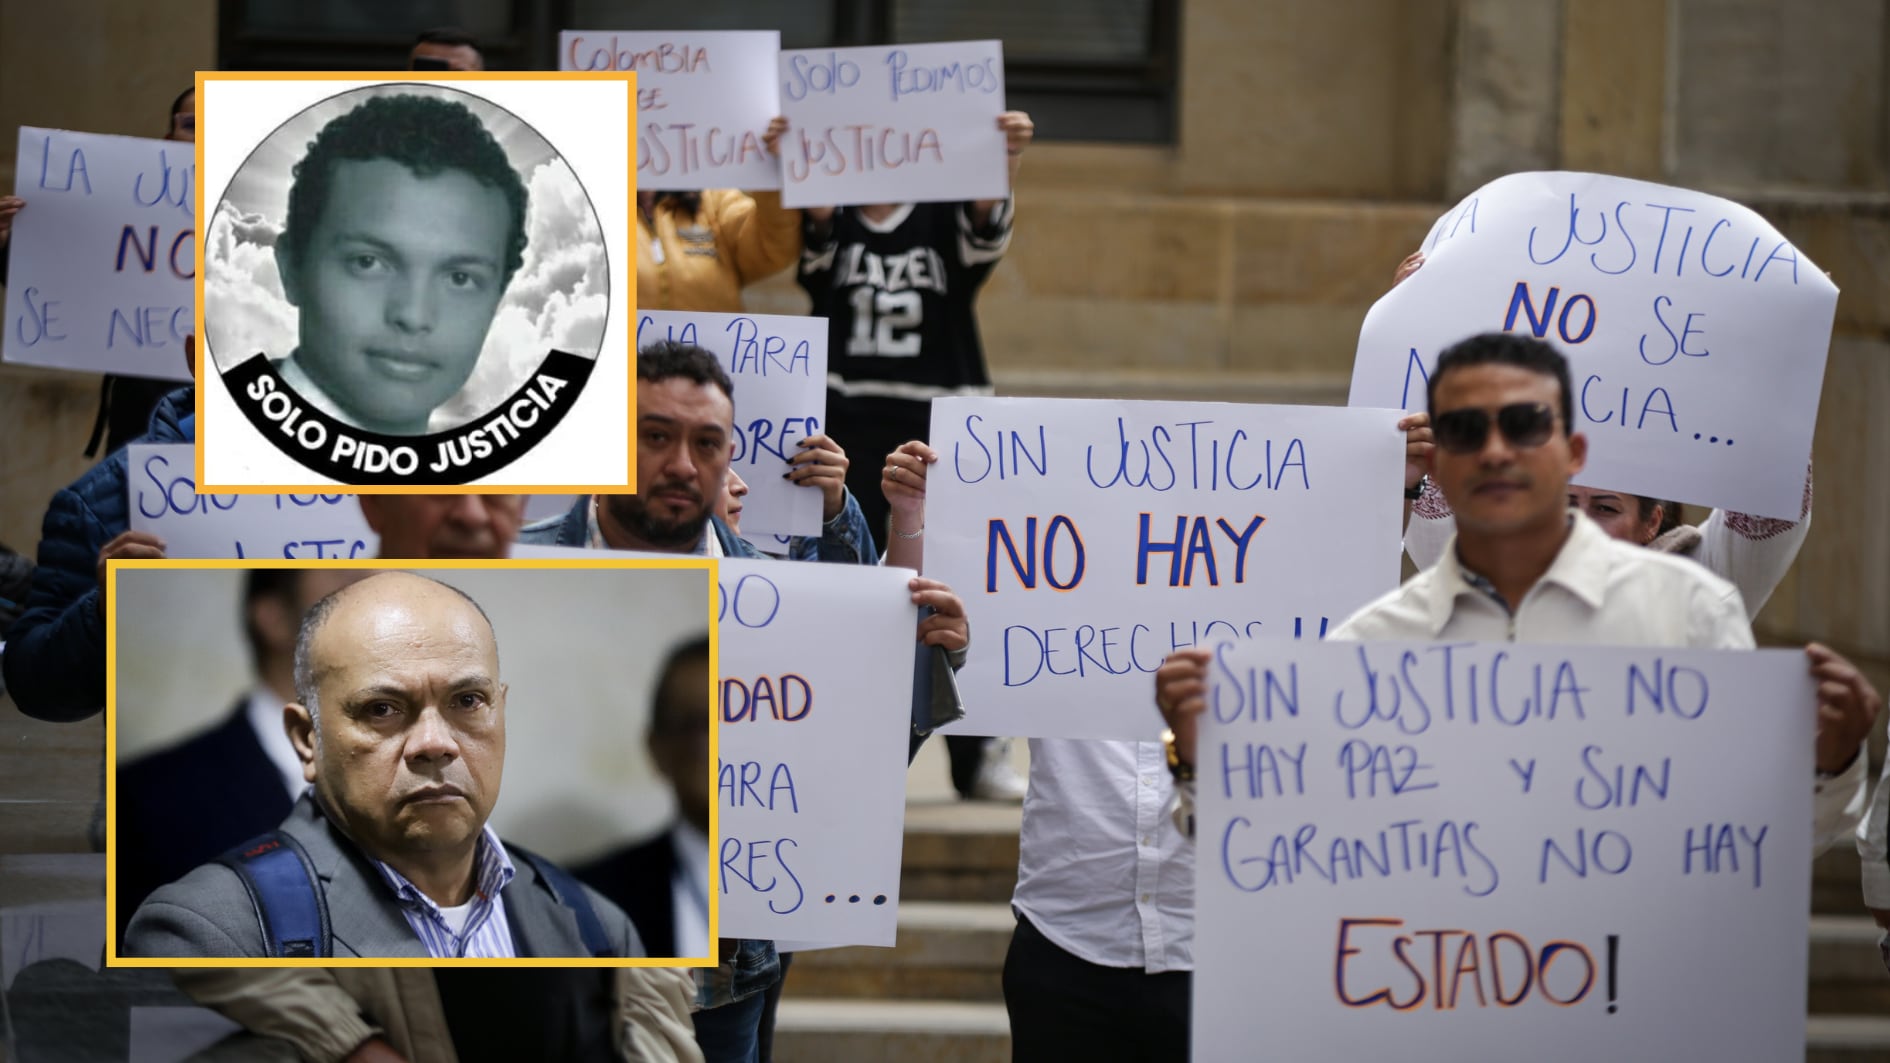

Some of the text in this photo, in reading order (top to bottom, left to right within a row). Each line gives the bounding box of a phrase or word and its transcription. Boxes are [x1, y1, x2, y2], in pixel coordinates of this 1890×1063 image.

[887, 50, 998, 101] PEDIMOS
[40, 135, 92, 195] LA
[788, 126, 944, 182] JUSTICIA
[1431, 193, 1799, 285] LA JUSTICIA
[16, 286, 68, 347] SE
[725, 317, 810, 377] PARA
[846, 285, 922, 357] 12
[1502, 281, 1710, 365] NO SE
[954, 414, 1310, 492] SIN JUSTICIA
[984, 511, 1267, 594] NO HAY
[1213, 643, 1710, 734] SIN JUSTICIA NO
[718, 757, 799, 814] ARA
[1221, 739, 1672, 811] HAY PAZ Y SIN
[1221, 816, 1769, 897] GARANTIAS NO HAY
[1334, 916, 1620, 1014] ESTADO!
